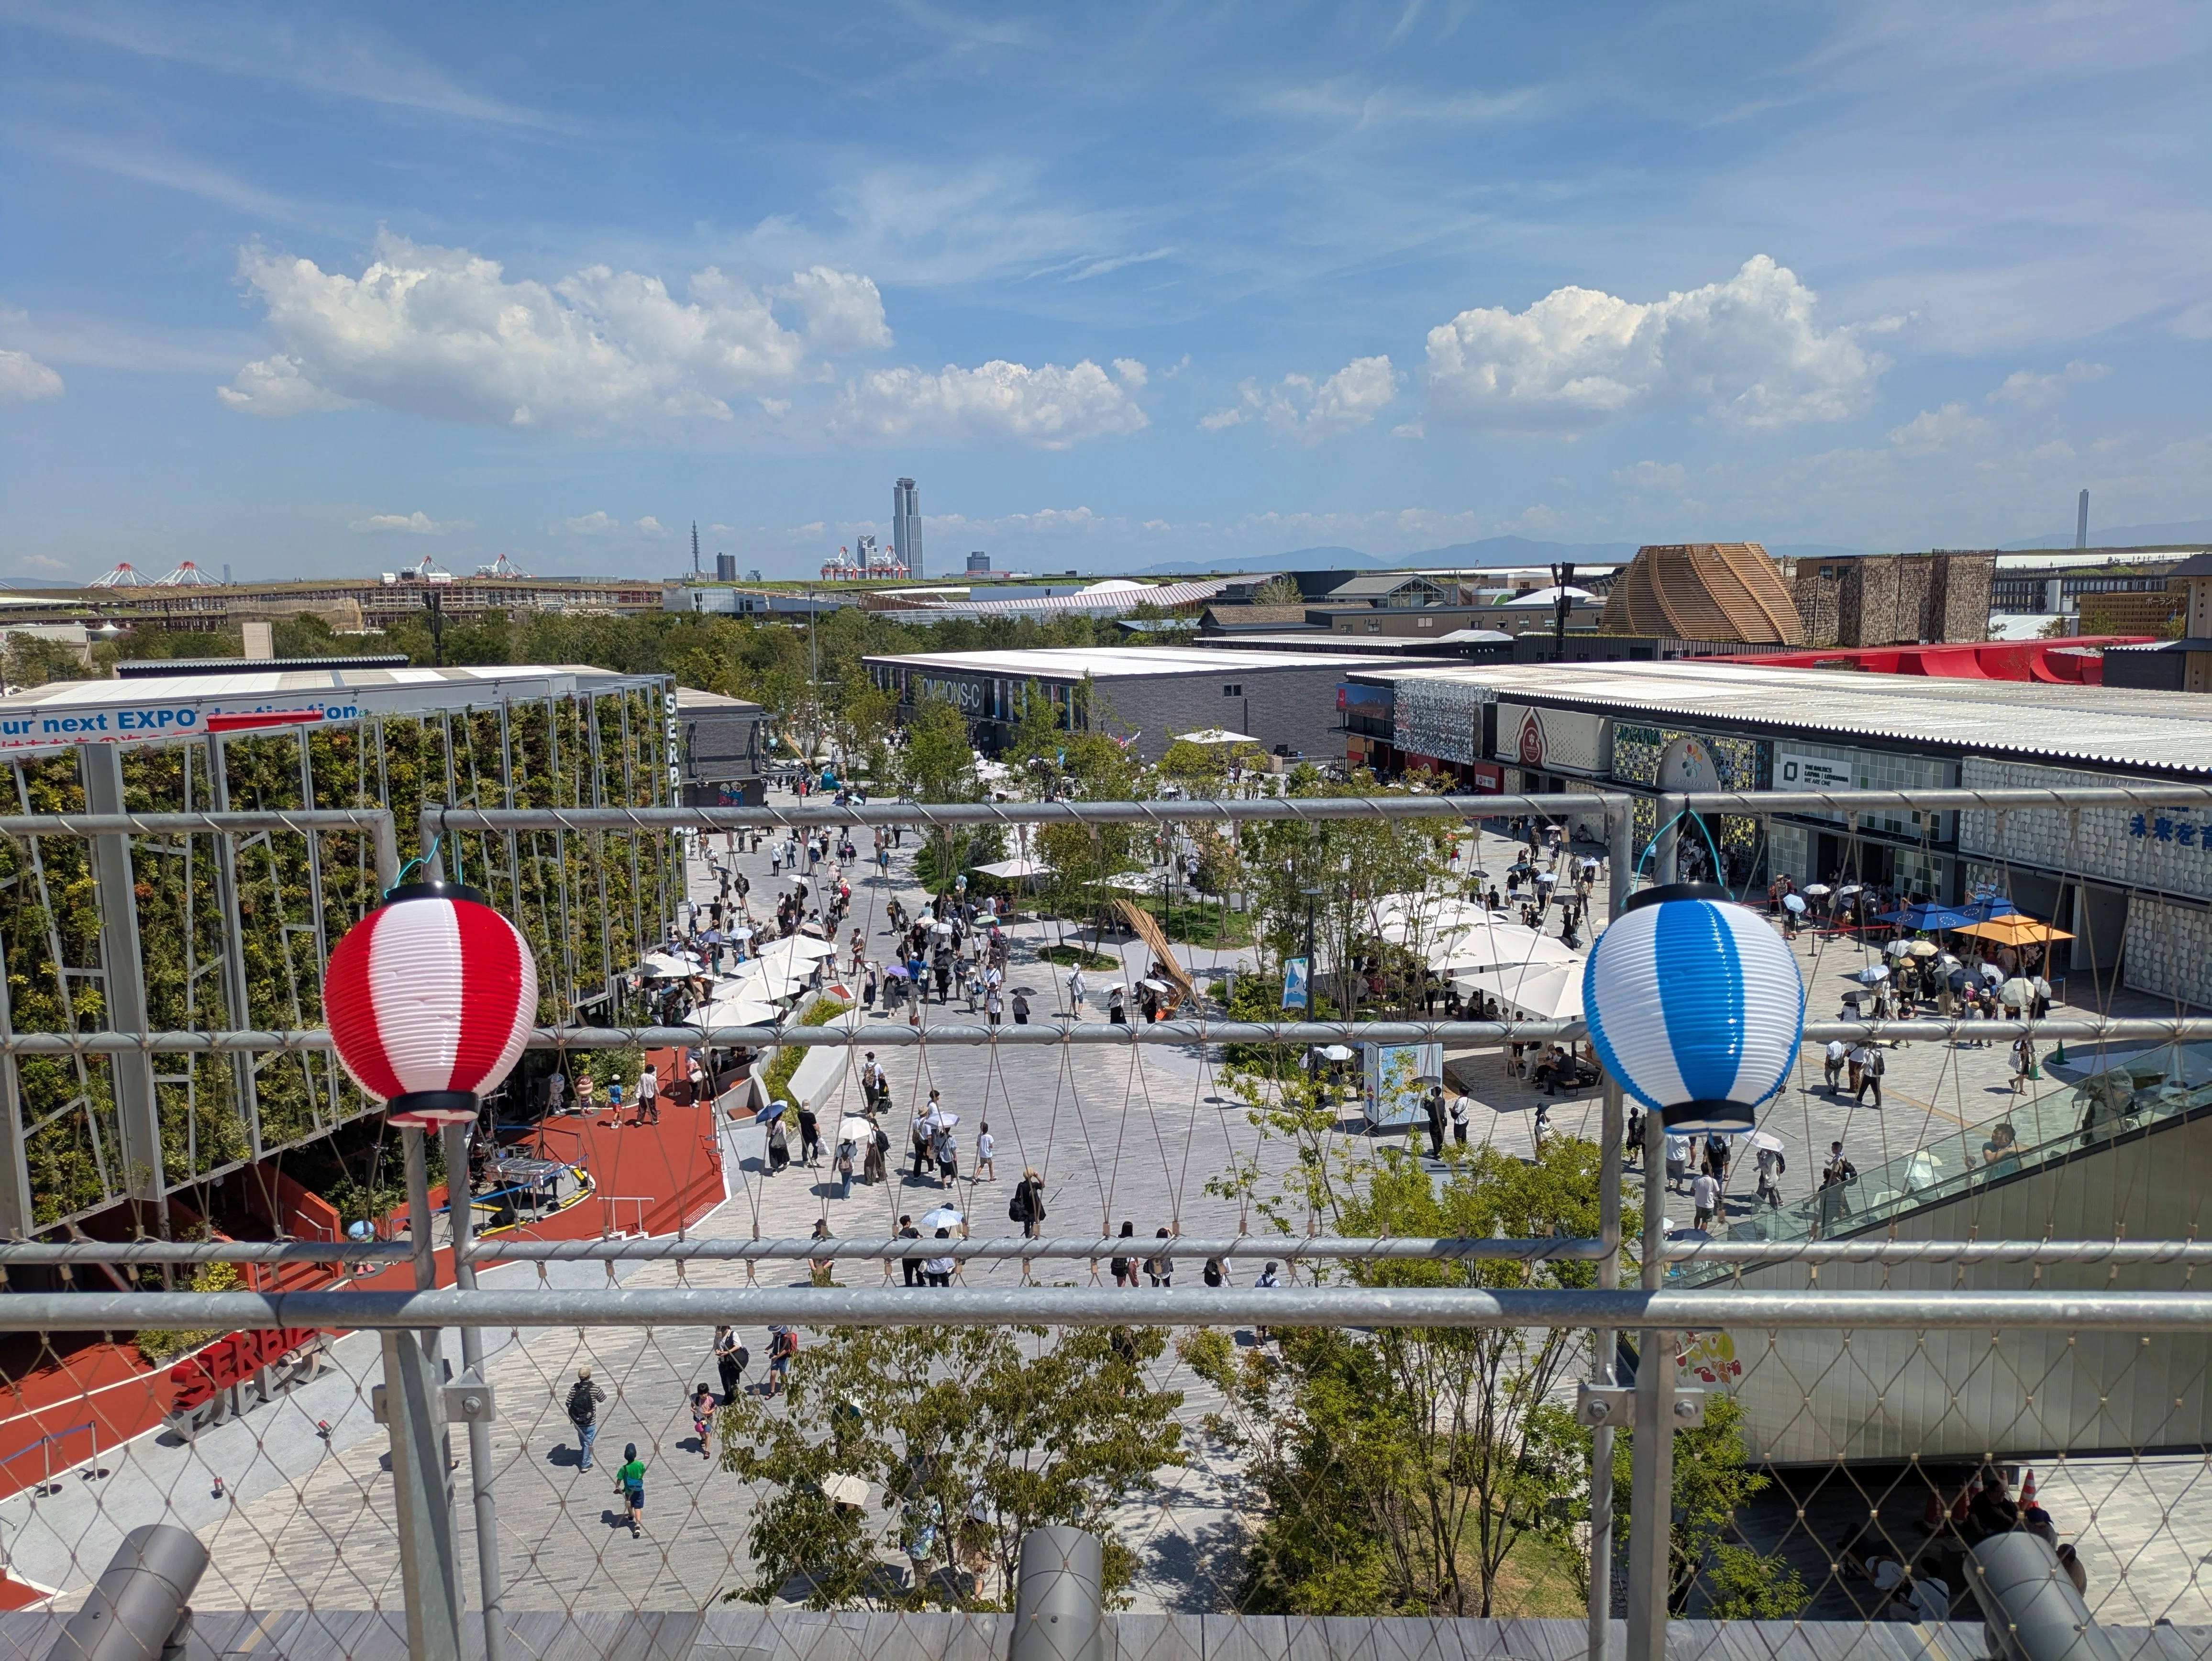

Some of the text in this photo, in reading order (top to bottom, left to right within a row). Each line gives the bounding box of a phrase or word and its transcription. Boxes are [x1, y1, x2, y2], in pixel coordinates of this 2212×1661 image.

[2145, 597, 2178, 605] ポーランド
[917, 677, 980, 708] OMMONS-C
[0, 720, 34, 735] ur
[44, 713, 108, 733] next
[118, 709, 196, 730] EXPO
[1824, 774, 1848, 783] LITHUANIA
